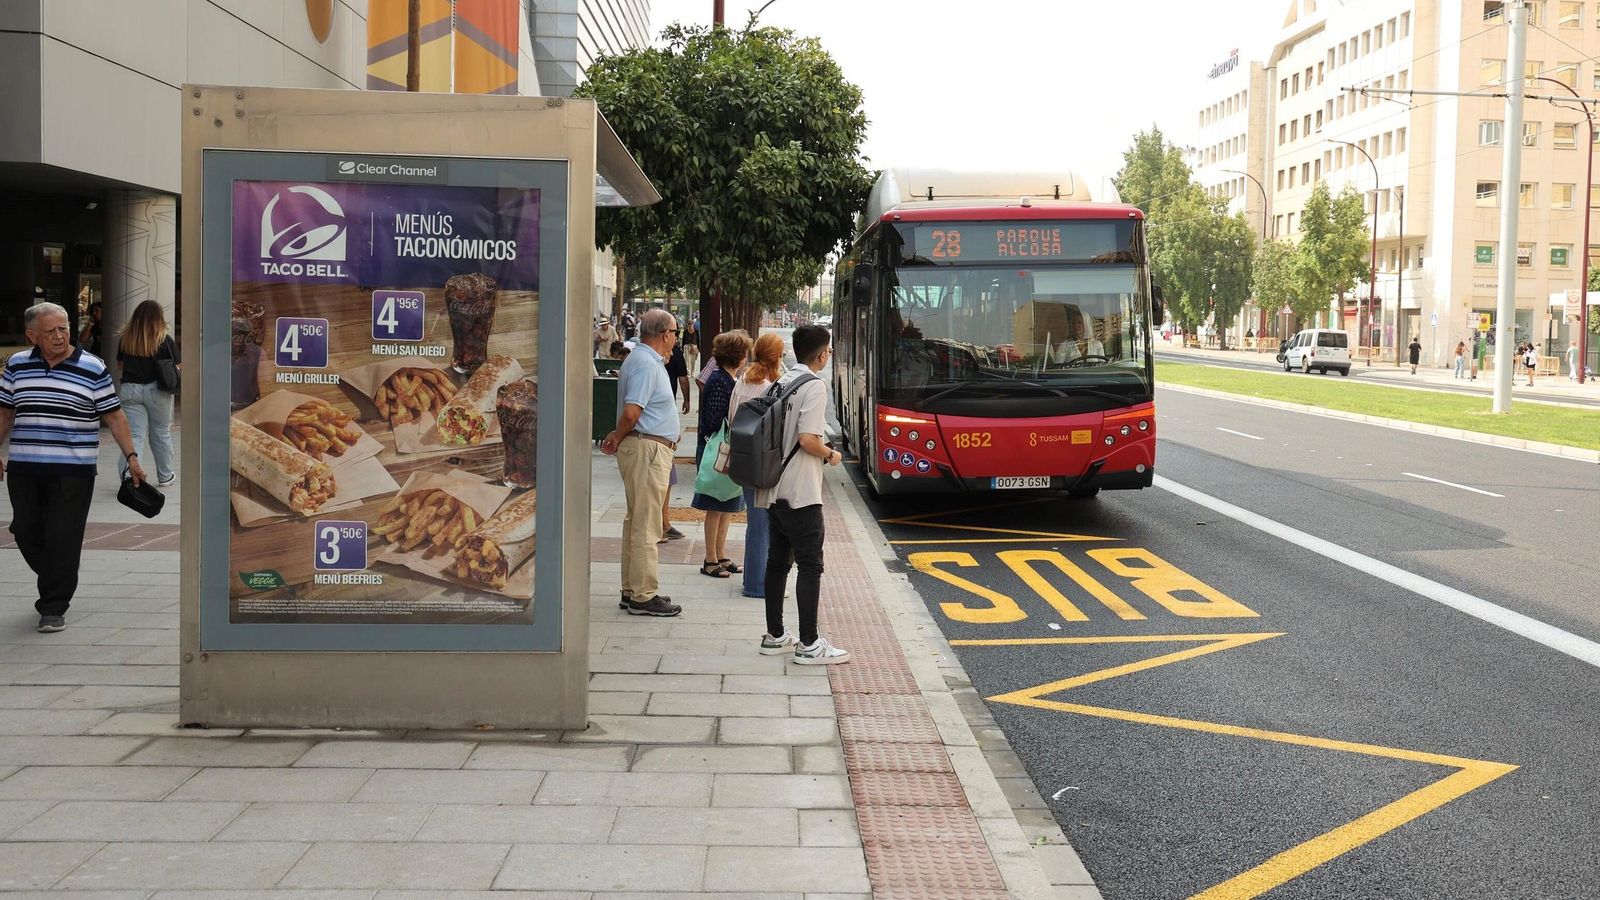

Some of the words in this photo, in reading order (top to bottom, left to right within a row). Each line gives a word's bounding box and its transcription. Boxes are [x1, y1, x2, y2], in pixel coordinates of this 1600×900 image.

[357, 163, 388, 176] Clear
[390, 164, 437, 177] Channel
[395, 212, 453, 236] MENÚS
[931, 229, 961, 257] 28
[996, 228, 1061, 243] PARQUE
[394, 233, 517, 261] TACONÓMICOS
[998, 242, 1062, 256] ALCOSA
[261, 262, 304, 277] TACO
[306, 264, 346, 278] BELL
[372, 342, 398, 356] MENÚ
[399, 345, 418, 356] SAN
[419, 345, 446, 357] DIEGO
[276, 370, 303, 384] MENÚ
[304, 373, 340, 385] GRILLER
[952, 432, 992, 449] 1852
[1039, 434, 1069, 443] TUSSAM
[998, 477, 1025, 487] 0073
[1027, 476, 1048, 487] GSN
[249, 577, 277, 585] VEGGIE
[314, 572, 341, 585] MENÚ
[342, 574, 383, 585] BEEFRIES
[907, 547, 1262, 625] BUS
